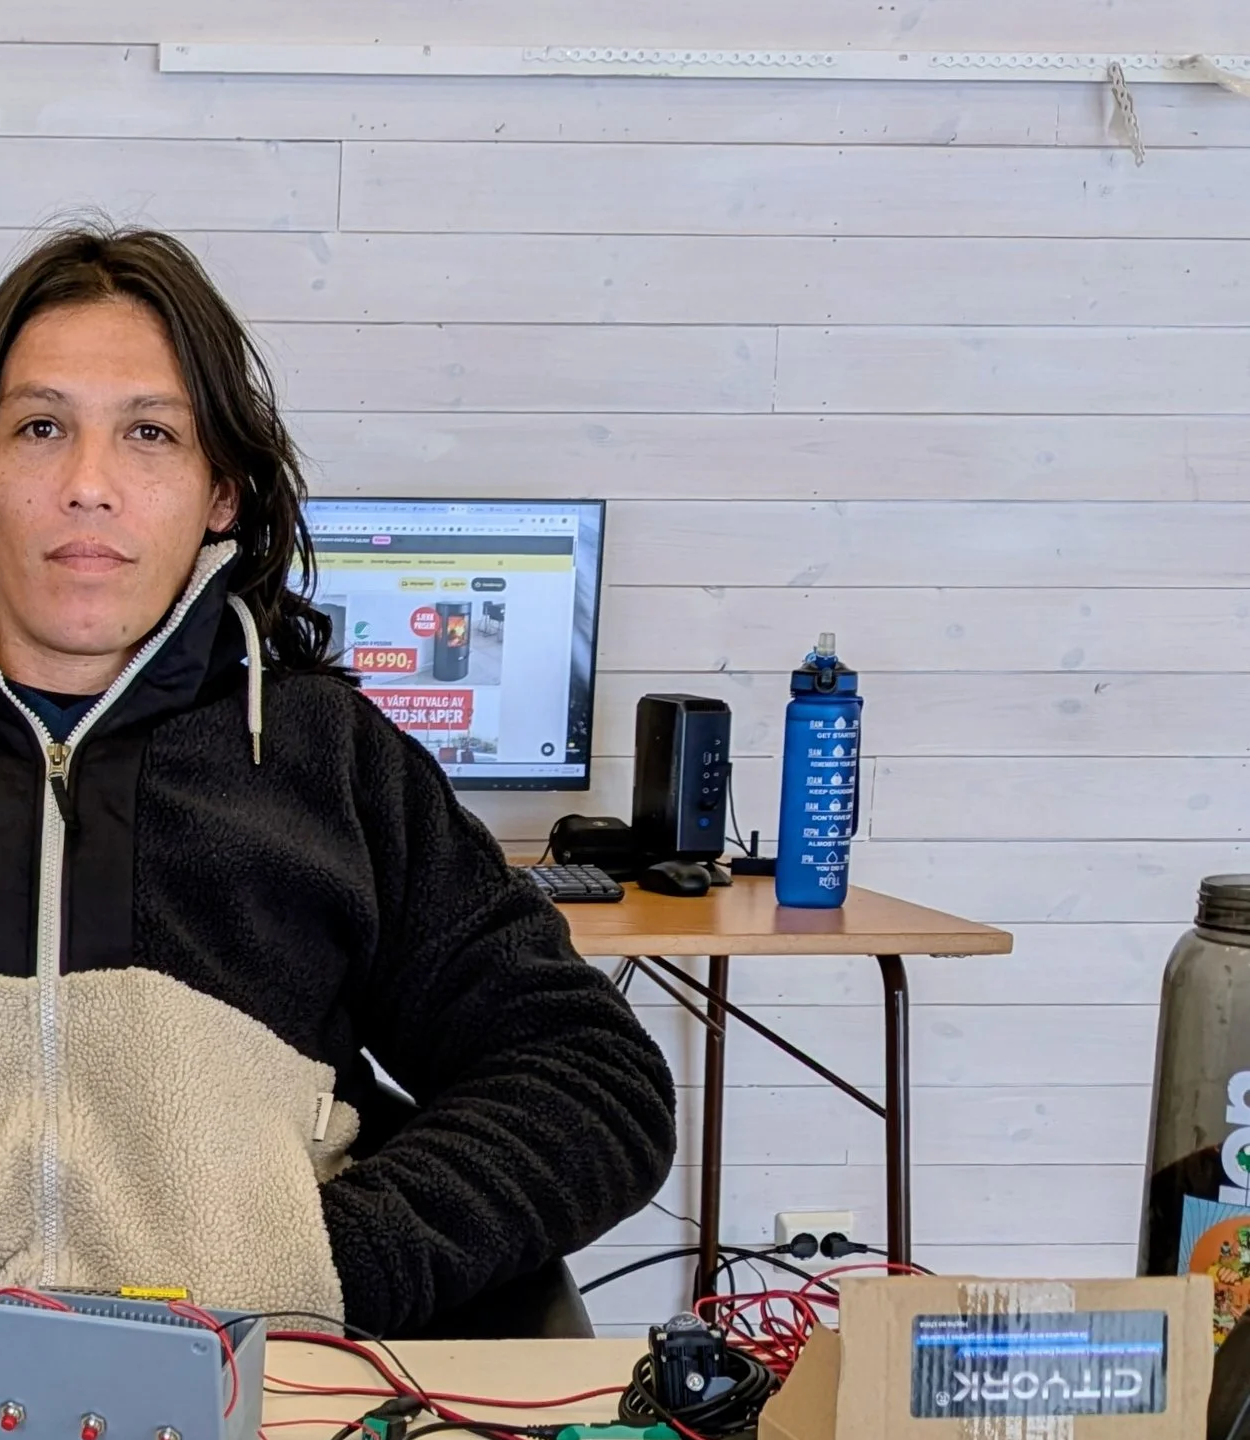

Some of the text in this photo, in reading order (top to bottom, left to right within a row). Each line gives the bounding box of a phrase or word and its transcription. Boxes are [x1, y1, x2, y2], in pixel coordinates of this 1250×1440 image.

[386, 694, 410, 706] VÅRT
[413, 696, 449, 707] UTVALG
[451, 697, 465, 707] AV
